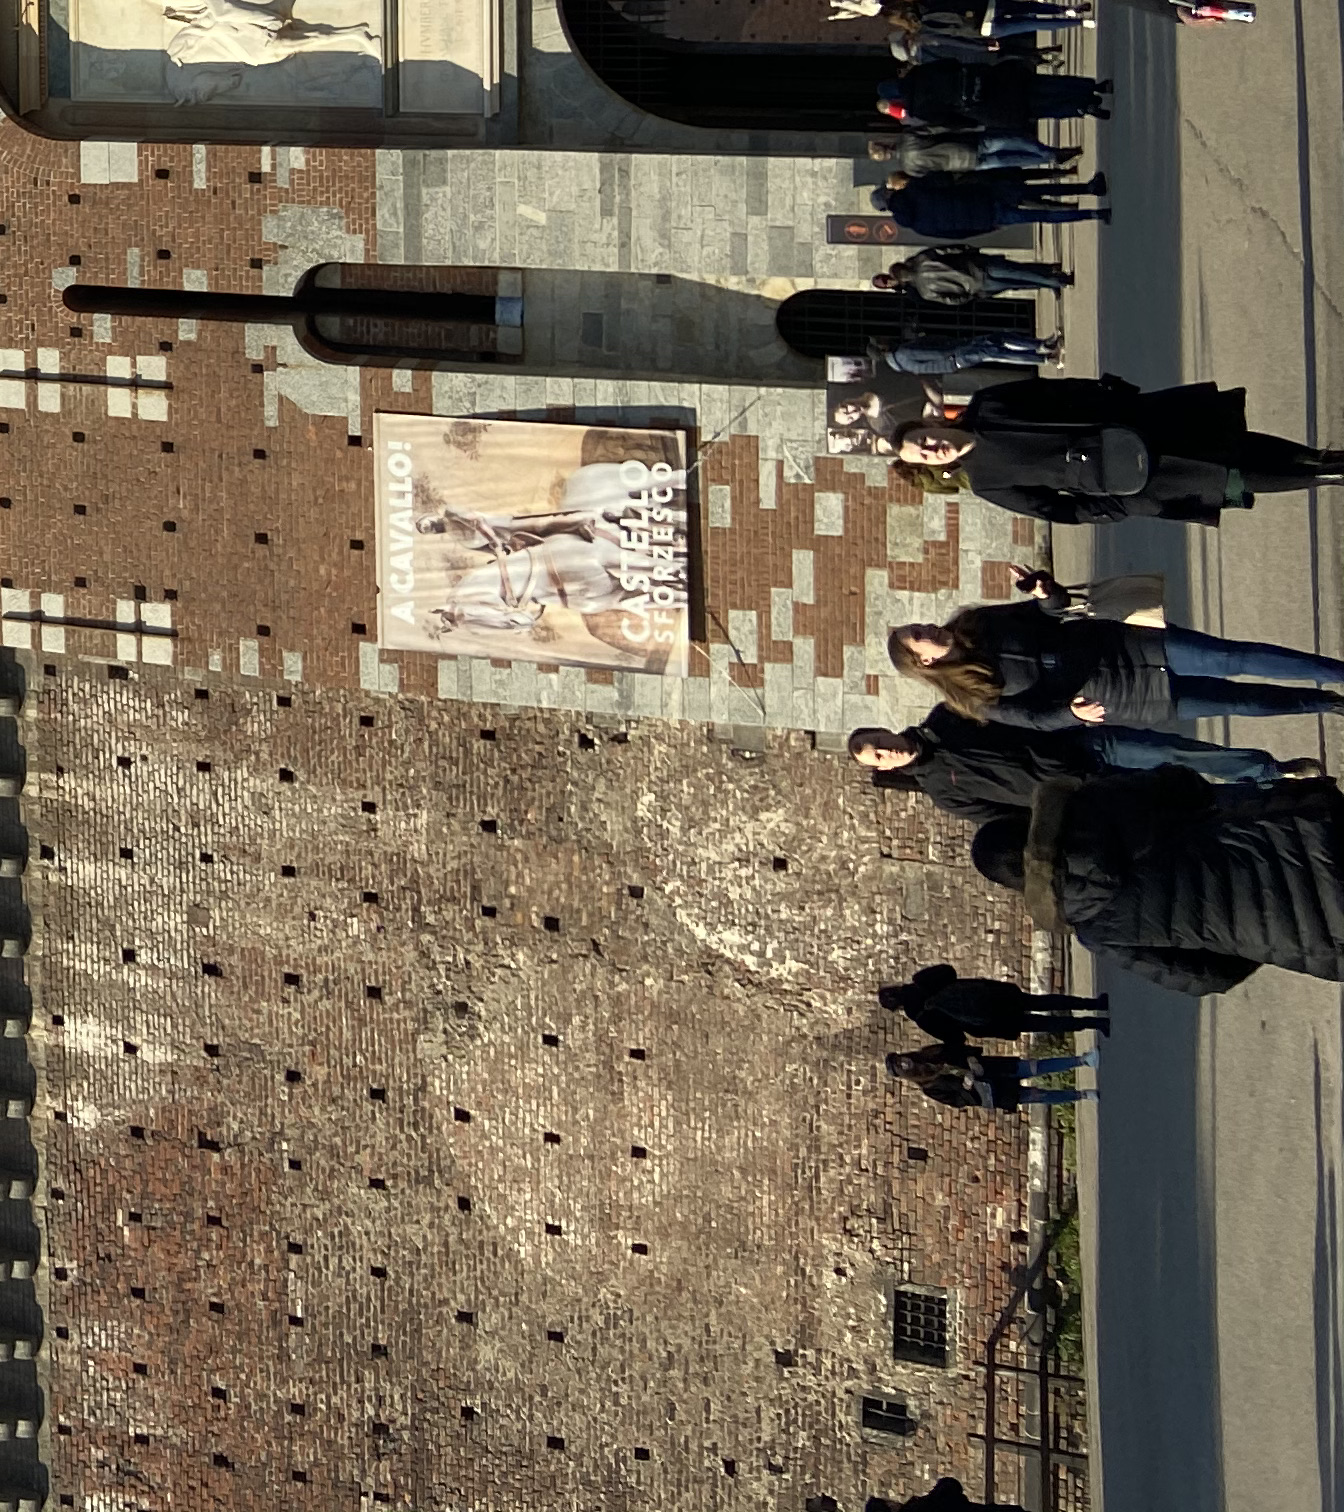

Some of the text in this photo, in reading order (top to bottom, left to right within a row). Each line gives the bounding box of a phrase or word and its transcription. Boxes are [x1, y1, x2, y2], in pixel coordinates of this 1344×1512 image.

[387, 440, 415, 624] A CAVALLO!
[619, 459, 651, 643] CASTELLO
[651, 460, 675, 644] SFORZESCO
